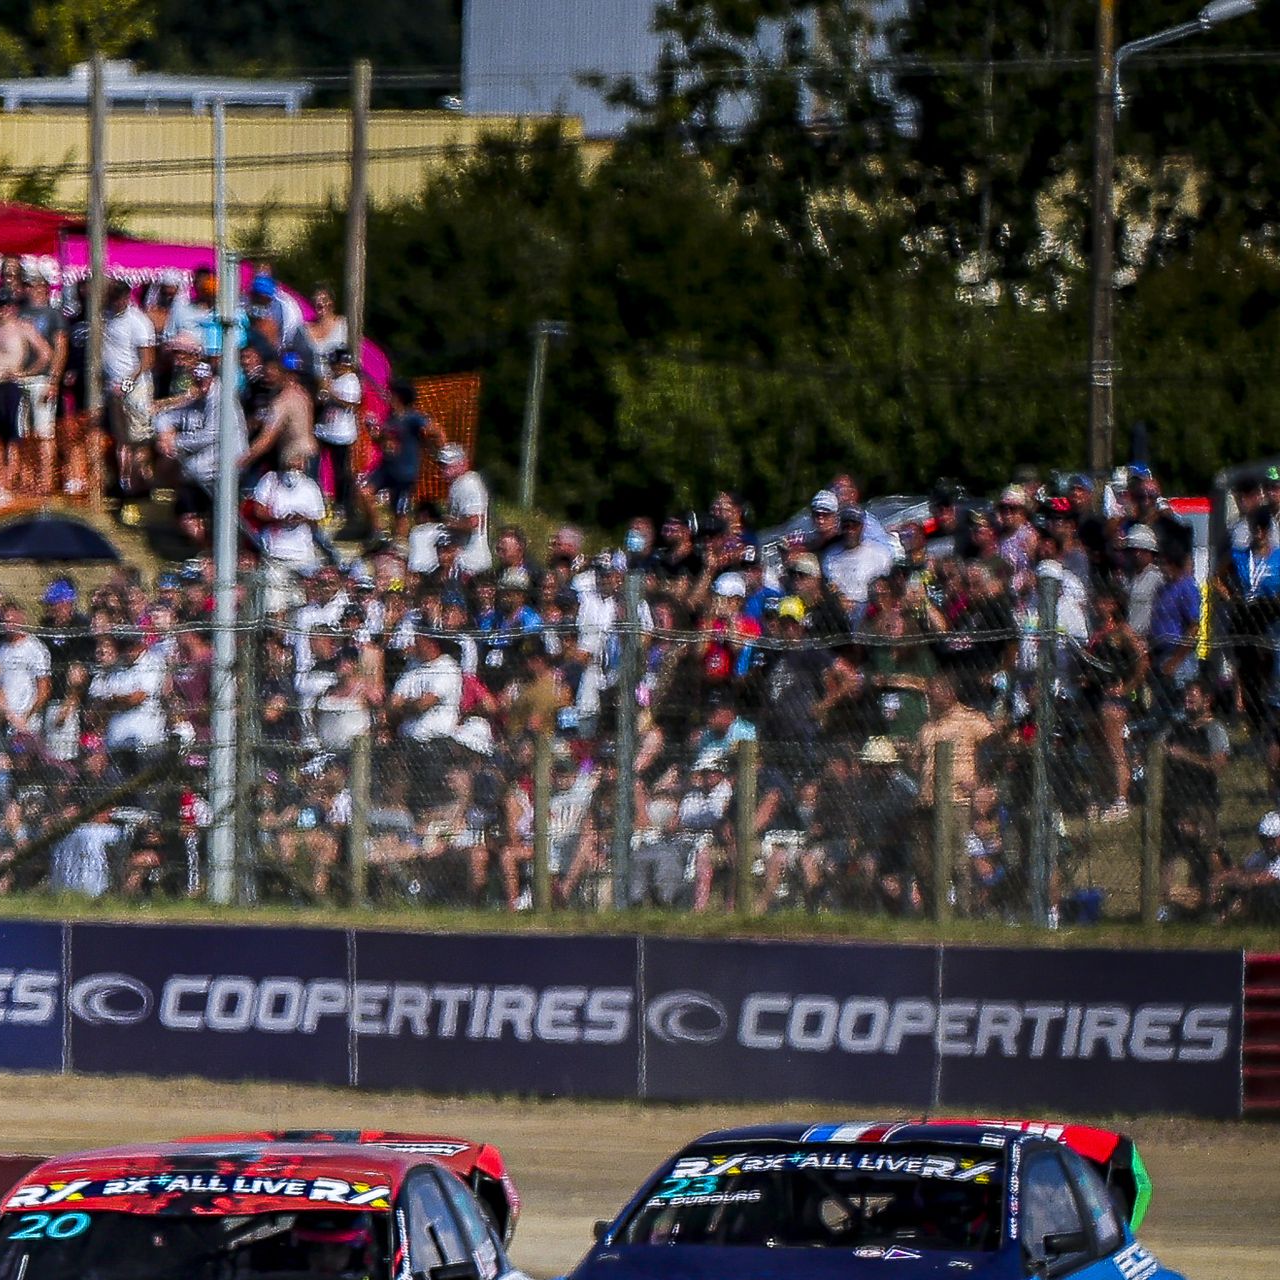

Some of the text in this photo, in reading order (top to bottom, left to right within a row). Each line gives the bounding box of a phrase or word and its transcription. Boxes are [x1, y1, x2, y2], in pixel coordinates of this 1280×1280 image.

[797, 1153, 852, 1169] ALL
[857, 1154, 922, 1173] LIVE
[166, 1175, 227, 1192] ALL
[232, 1177, 306, 1195] LIVE
[656, 1175, 719, 1198] 23
[7, 1211, 92, 1240] 20
